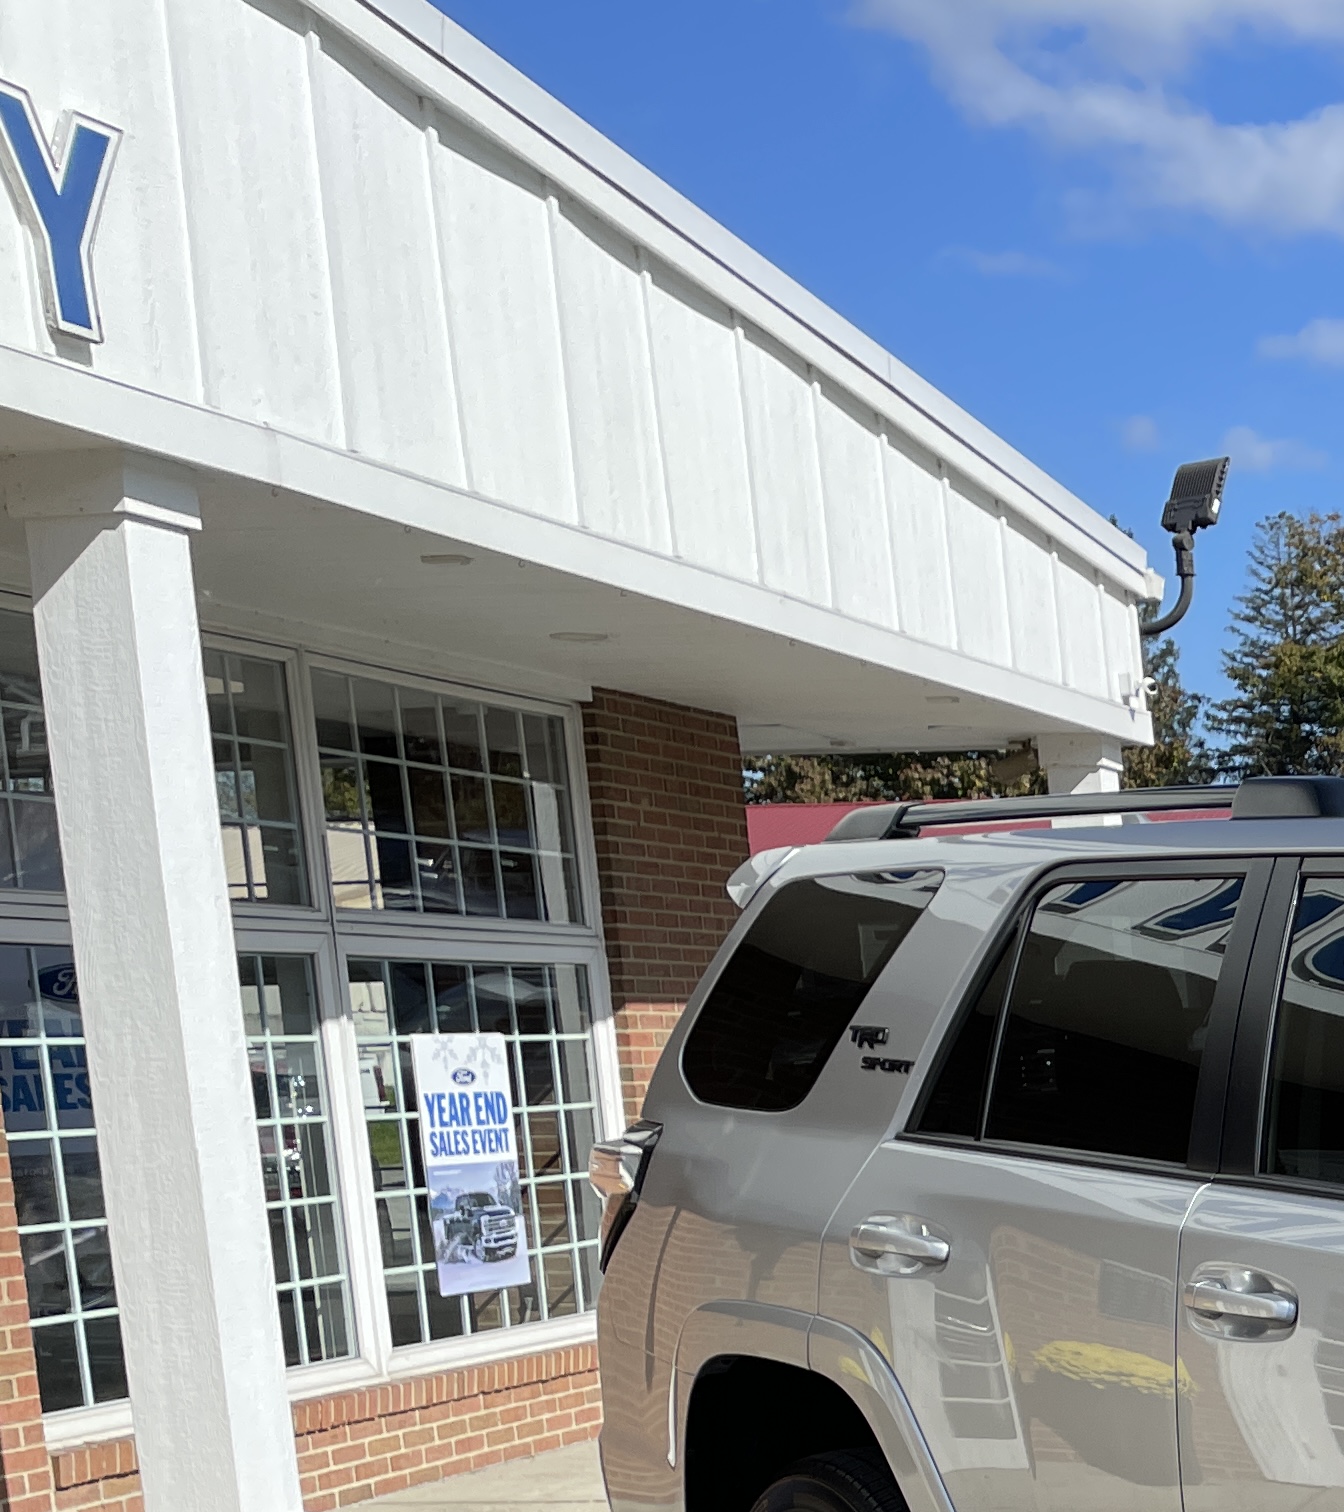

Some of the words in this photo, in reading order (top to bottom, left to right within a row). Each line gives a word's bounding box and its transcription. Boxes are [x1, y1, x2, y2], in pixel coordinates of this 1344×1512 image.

[849, 1025, 889, 1050] TRD
[861, 1056, 915, 1075] SPORT
[423, 1092, 472, 1128] YEAR
[473, 1091, 508, 1126] END
[429, 1129, 470, 1157] SALES
[471, 1127, 510, 1155] EVENT
